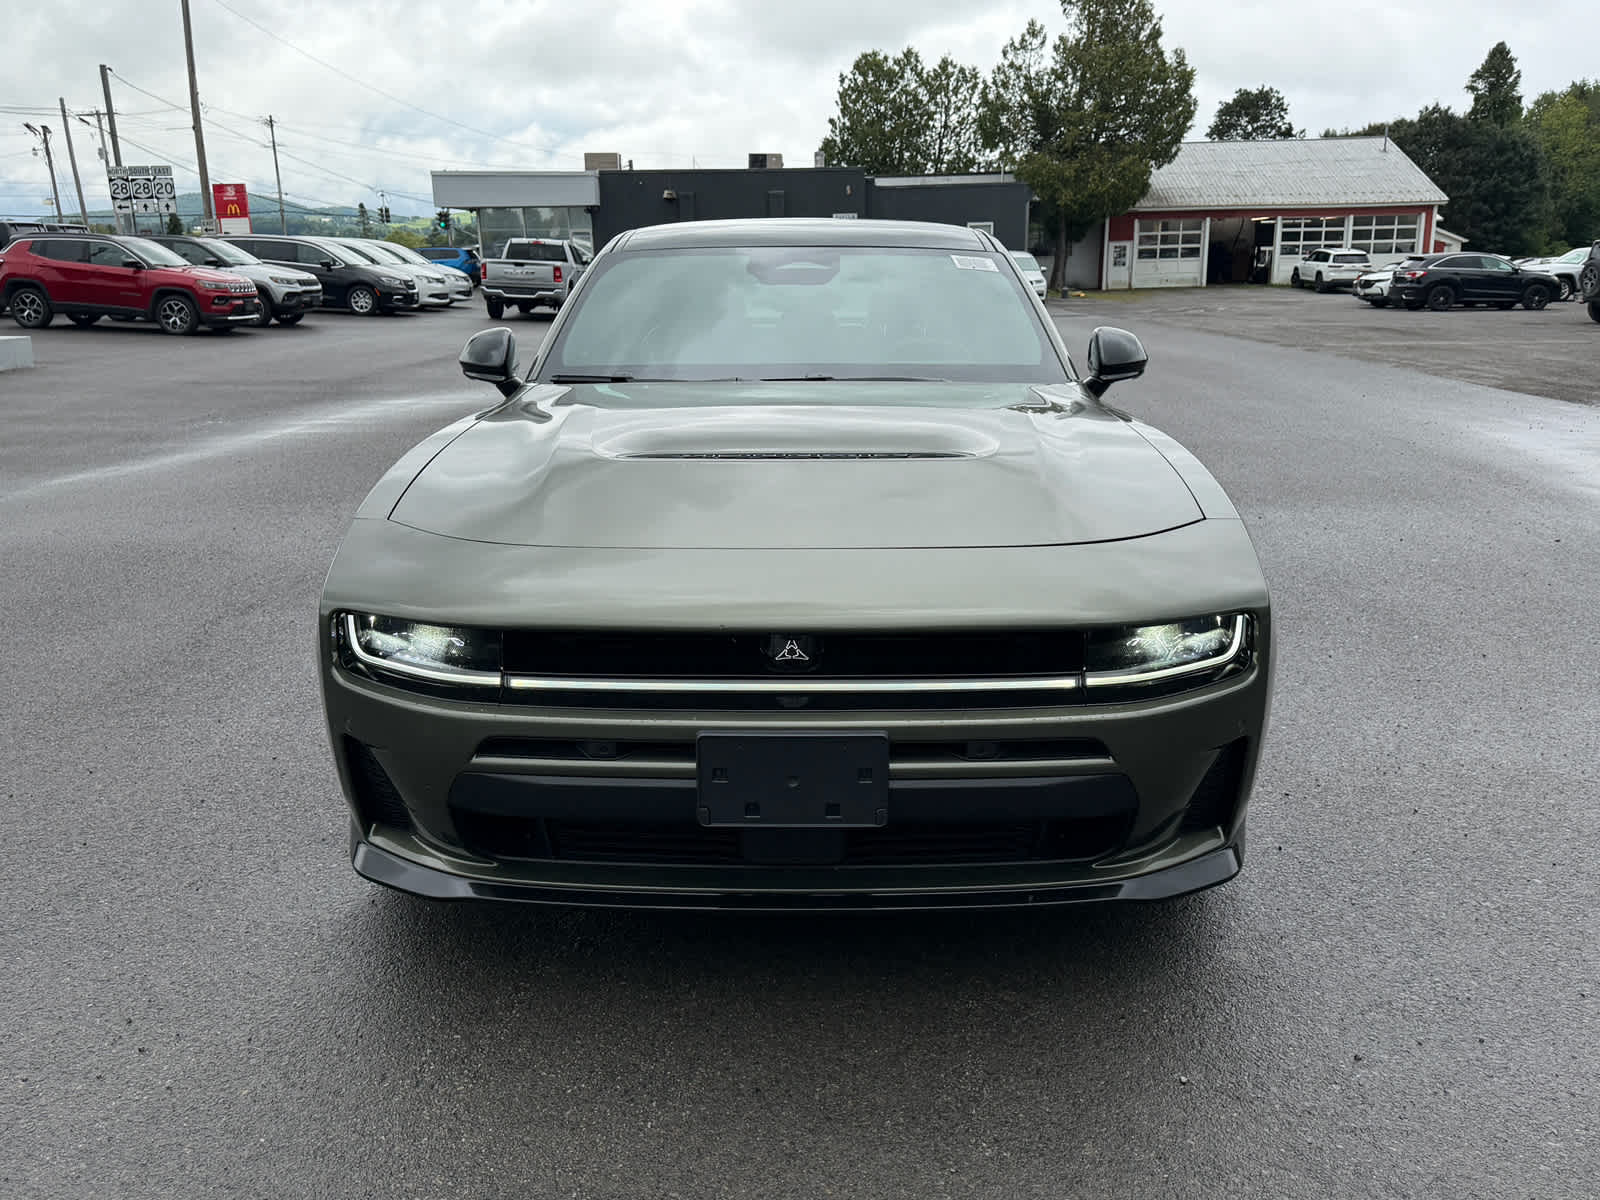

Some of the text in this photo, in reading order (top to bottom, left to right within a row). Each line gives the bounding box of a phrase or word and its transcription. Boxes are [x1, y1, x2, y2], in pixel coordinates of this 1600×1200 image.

[130, 168, 150, 176] SOUTH
[153, 168, 169, 176] EAST
[112, 182, 129, 195] 28
[134, 182, 151, 195] 28
[156, 182, 173, 195] 20
